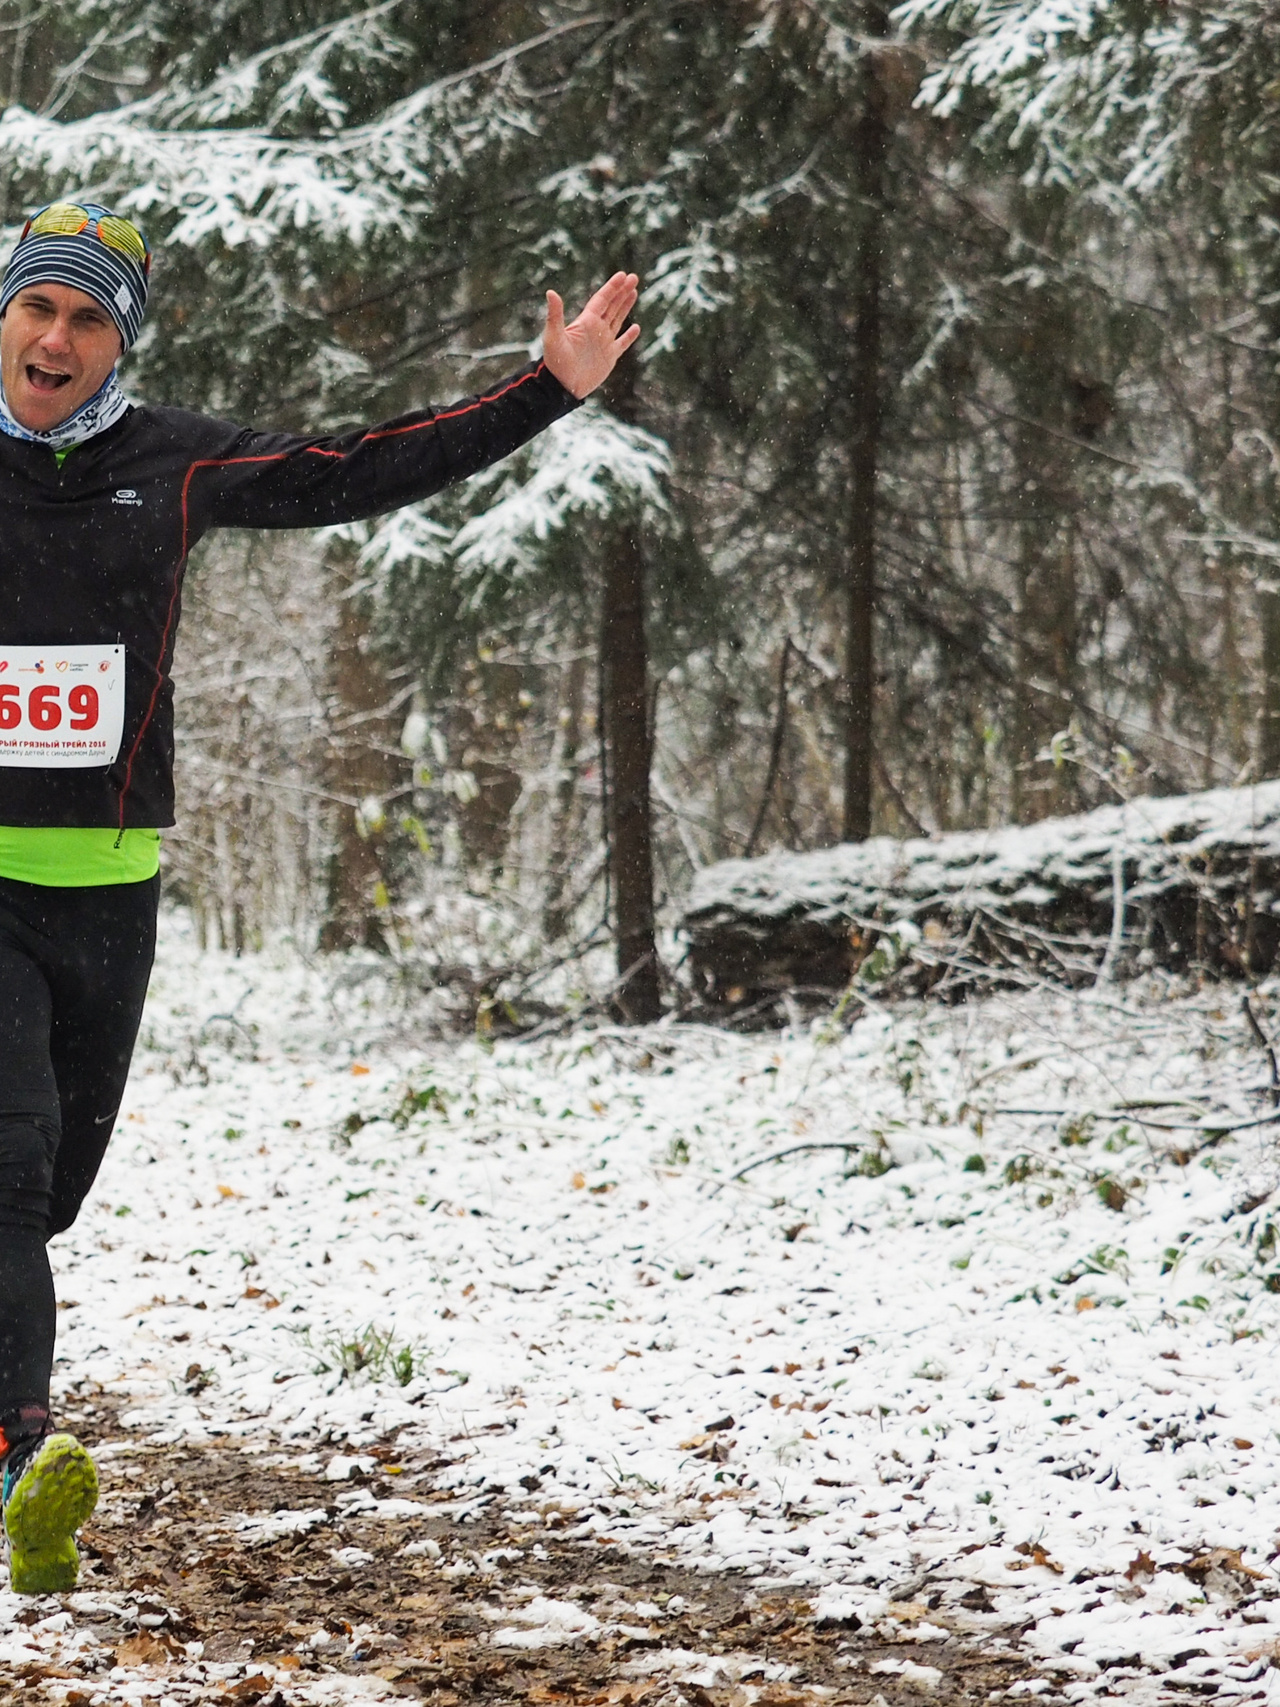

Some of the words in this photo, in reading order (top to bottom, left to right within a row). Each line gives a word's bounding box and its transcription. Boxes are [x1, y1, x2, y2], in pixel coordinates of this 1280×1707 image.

[111, 497, 143, 507] Kalenji
[19, 739, 60, 748] ГРЯЗНЫЙ
[61, 739, 87, 748] ТРЕЙЛ
